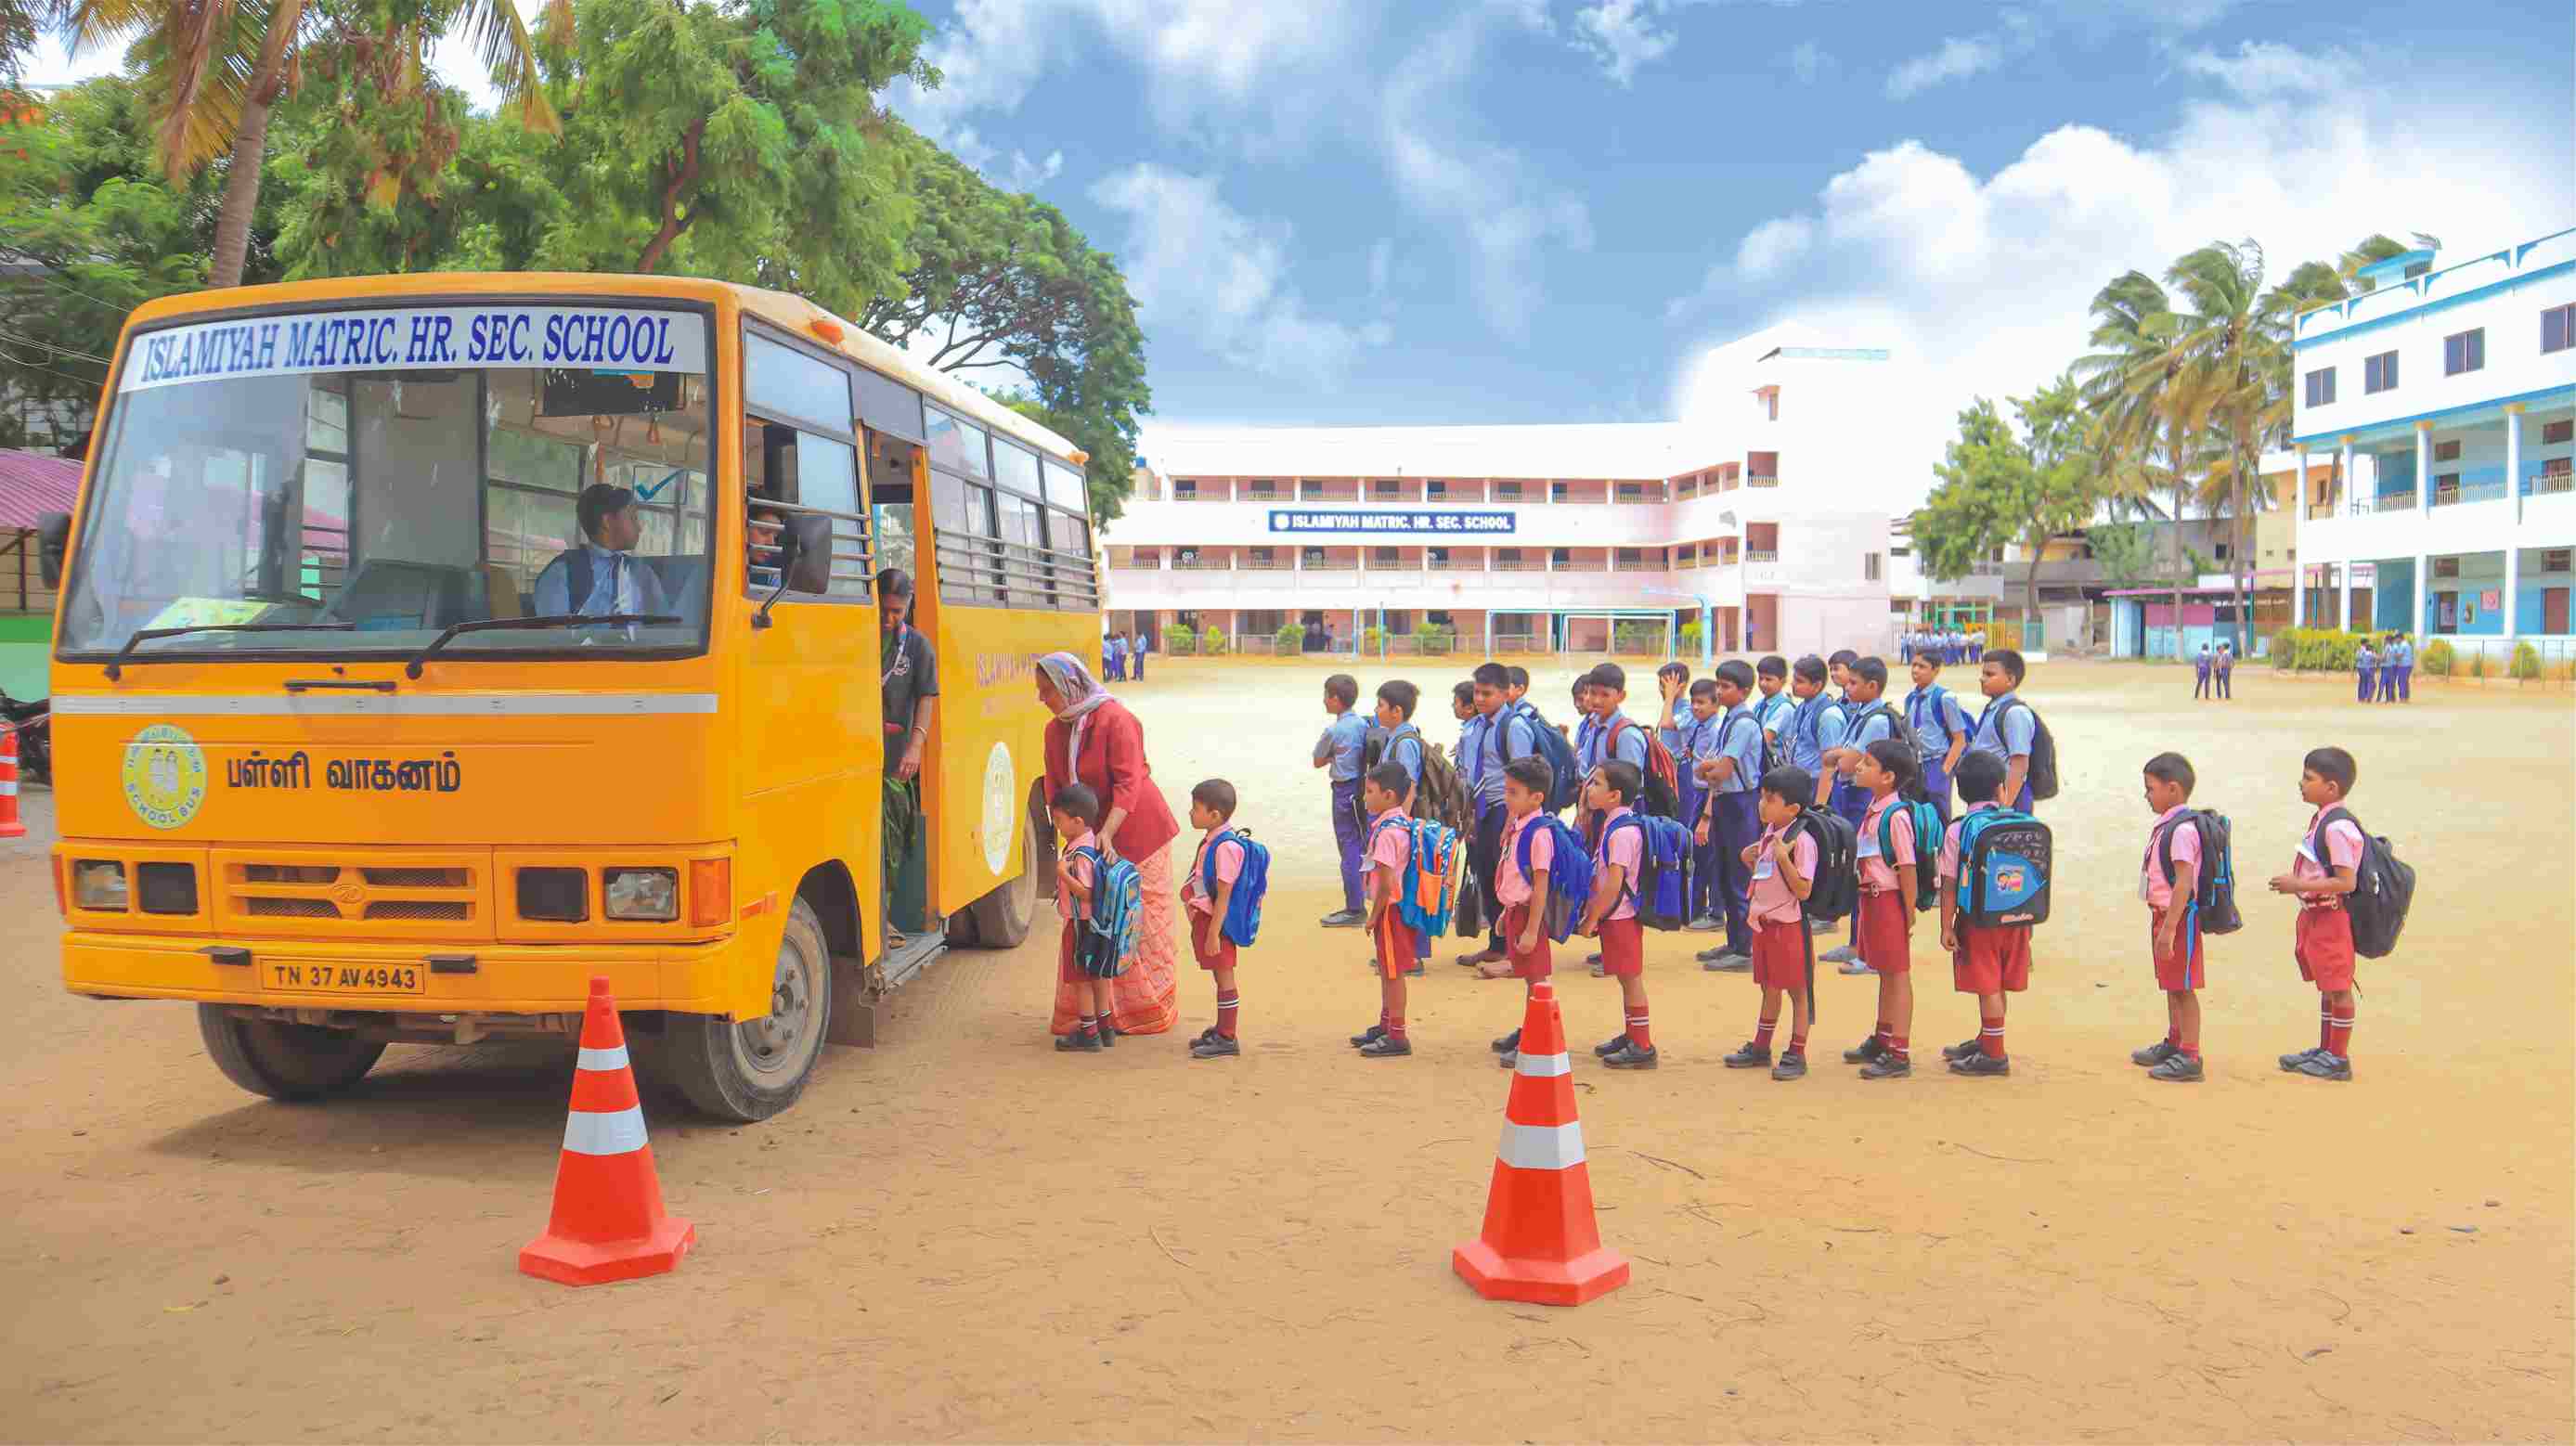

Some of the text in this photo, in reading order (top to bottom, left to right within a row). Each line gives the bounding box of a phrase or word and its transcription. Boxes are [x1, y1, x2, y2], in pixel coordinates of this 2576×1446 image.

[140, 314, 675, 382] ISLAMIYAH MATRIC. HR. SEC. SCHOOL
[1291, 513, 1511, 530] ISLAMIYAH MATRIC. HR. SEC. SCHOOL
[227, 750, 311, 790] பள்ளி
[275, 965, 301, 986] TN
[310, 966, 333, 987] 37
